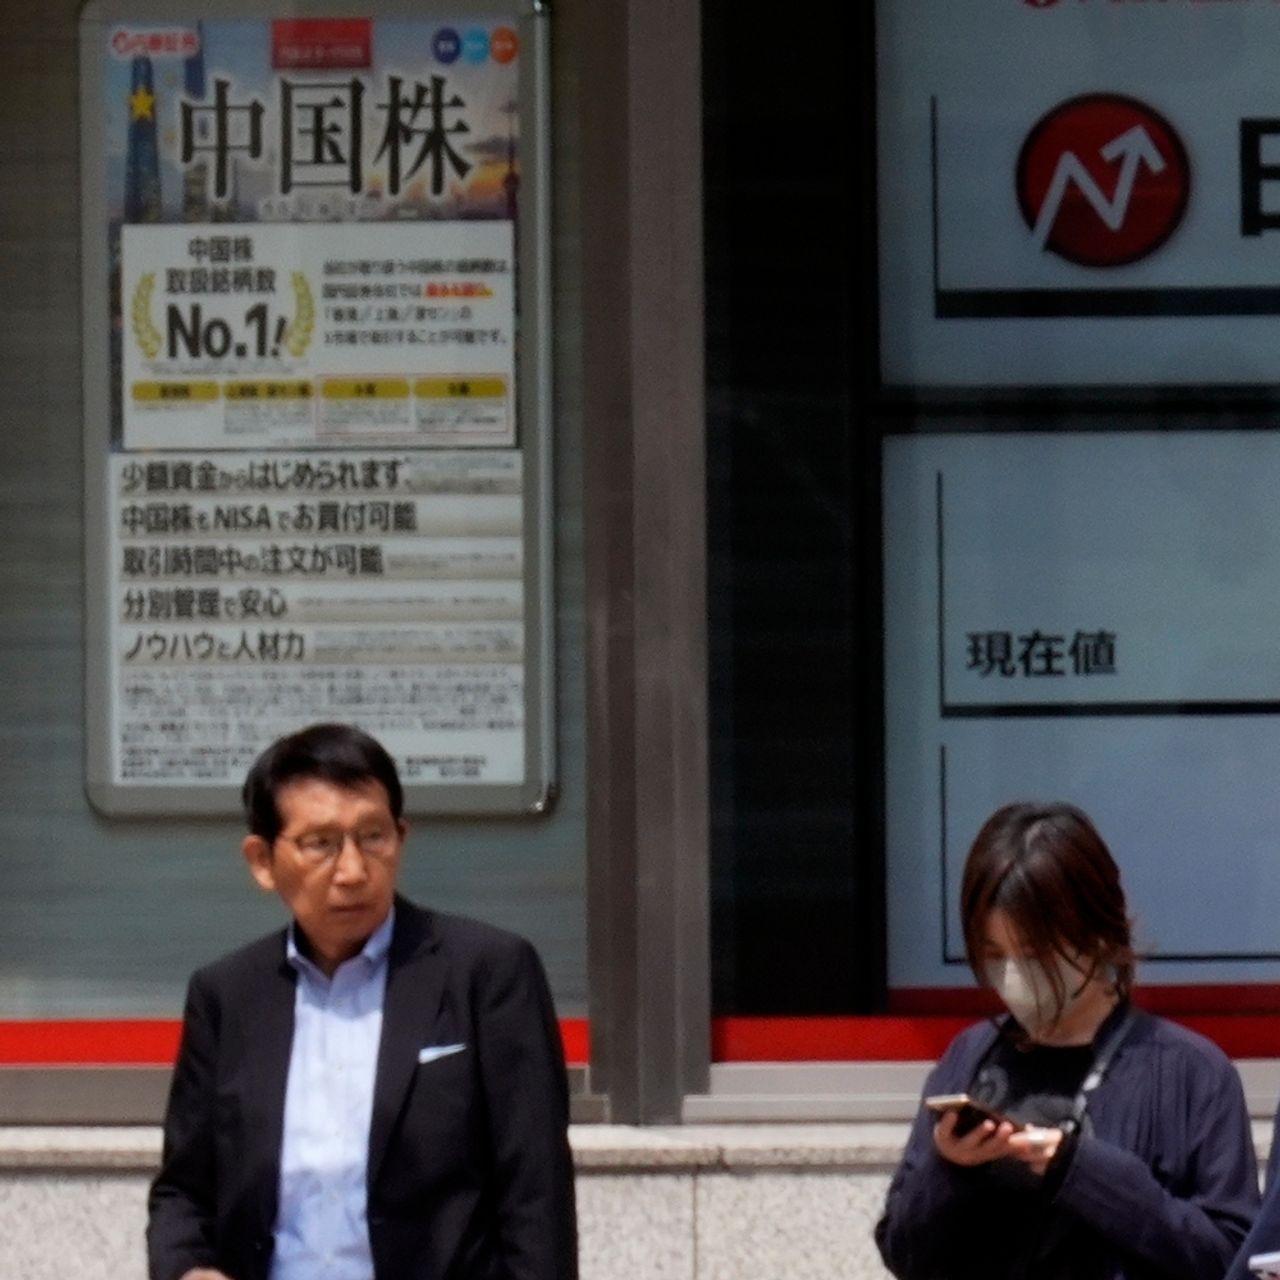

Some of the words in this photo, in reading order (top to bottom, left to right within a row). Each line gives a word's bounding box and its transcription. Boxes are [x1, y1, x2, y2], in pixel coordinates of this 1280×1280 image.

[180, 75, 472, 197] 中国株
[188, 236, 252, 262] 中国株
[967, 628, 1118, 678] 現在値
